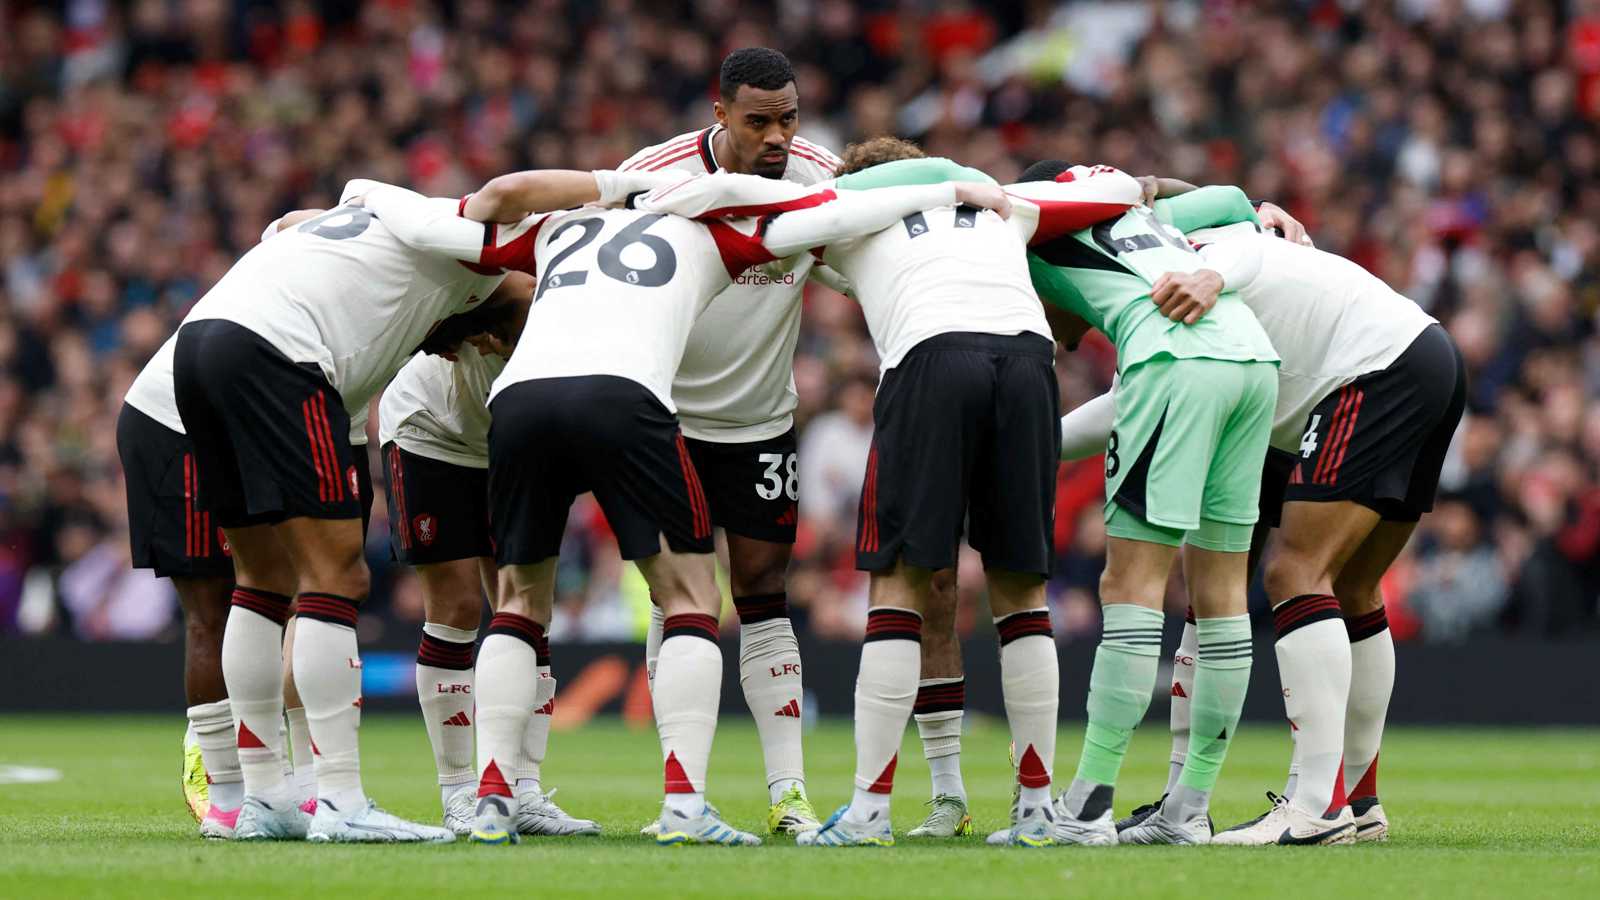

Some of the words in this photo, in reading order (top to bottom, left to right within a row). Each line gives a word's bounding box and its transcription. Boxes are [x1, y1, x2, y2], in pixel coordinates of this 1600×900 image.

[535, 213, 677, 303] 26
[733, 271, 795, 286] artered
[1299, 414, 1322, 459] 4
[755, 453, 800, 501] 38
[770, 663, 801, 678] LFC
[438, 683, 472, 694] LFC
